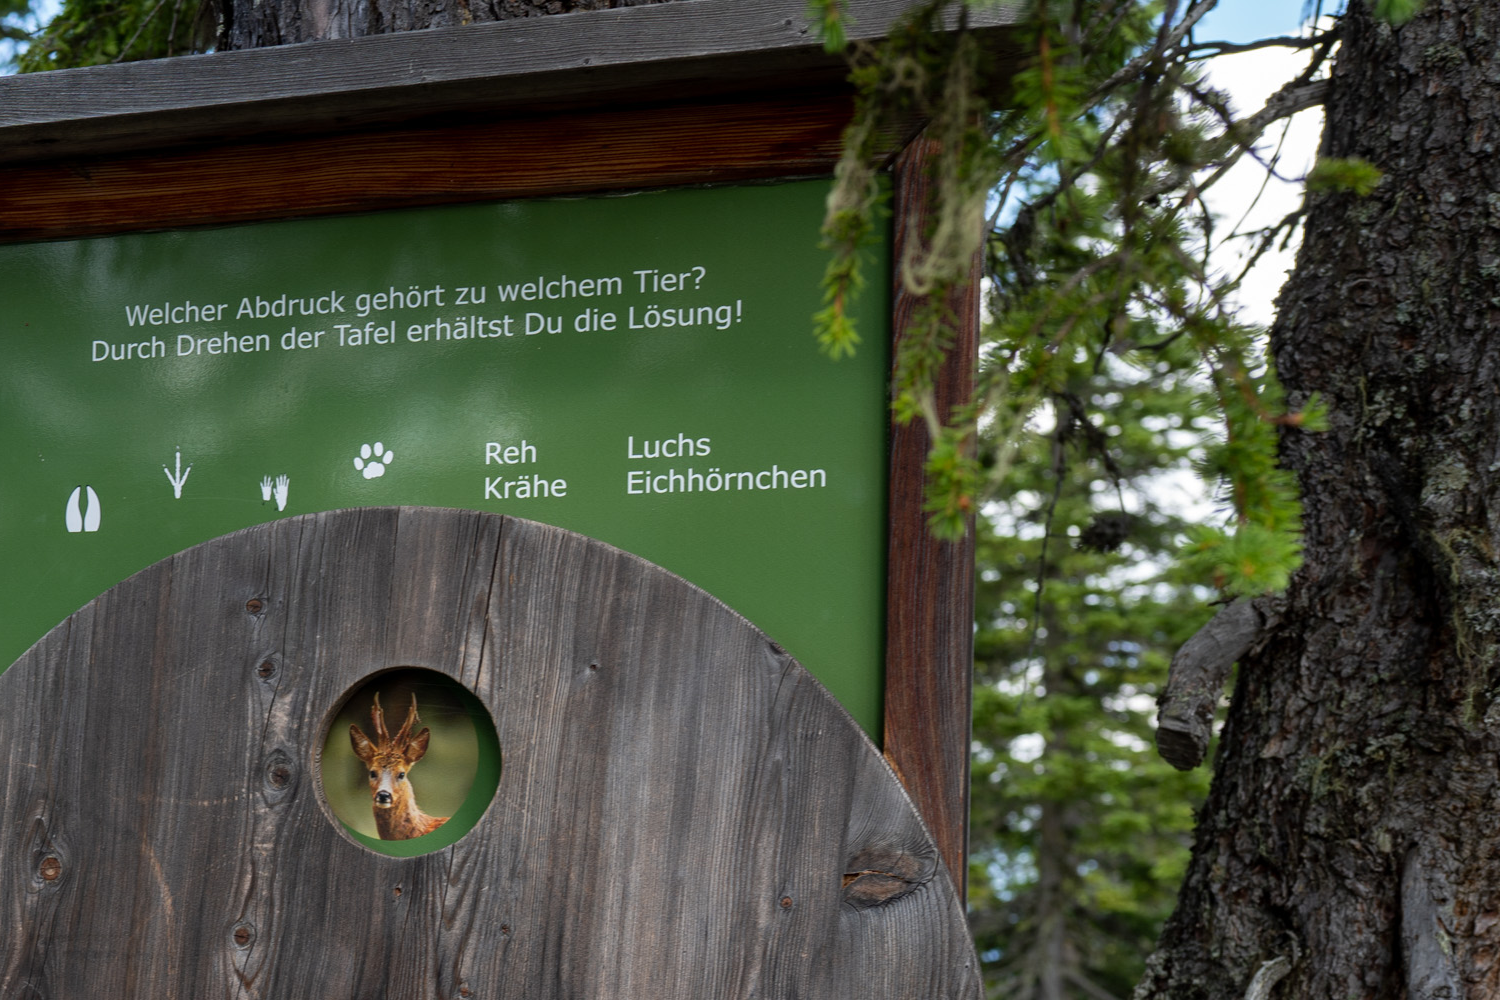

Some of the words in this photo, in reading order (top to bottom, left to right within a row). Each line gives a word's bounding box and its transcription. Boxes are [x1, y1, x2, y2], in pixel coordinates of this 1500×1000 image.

[126, 301, 228, 327] Welcher
[236, 290, 345, 320] Abdruck
[355, 285, 445, 317] gehört
[455, 286, 486, 305] zu
[498, 275, 622, 302] welchem
[633, 266, 706, 293] Tier?
[91, 336, 166, 362] Durch
[177, 331, 271, 357] Drehen
[280, 327, 325, 350] der
[333, 320, 396, 347] Tafel
[406, 315, 514, 342] erhältst
[525, 312, 563, 335] Du
[574, 308, 616, 333] die
[628, 300, 743, 331] Lösung!
[485, 439, 537, 465] Reh
[627, 432, 711, 459] Luchs
[484, 474, 567, 500] Krähe
[626, 464, 827, 495] Eichhörnchen
